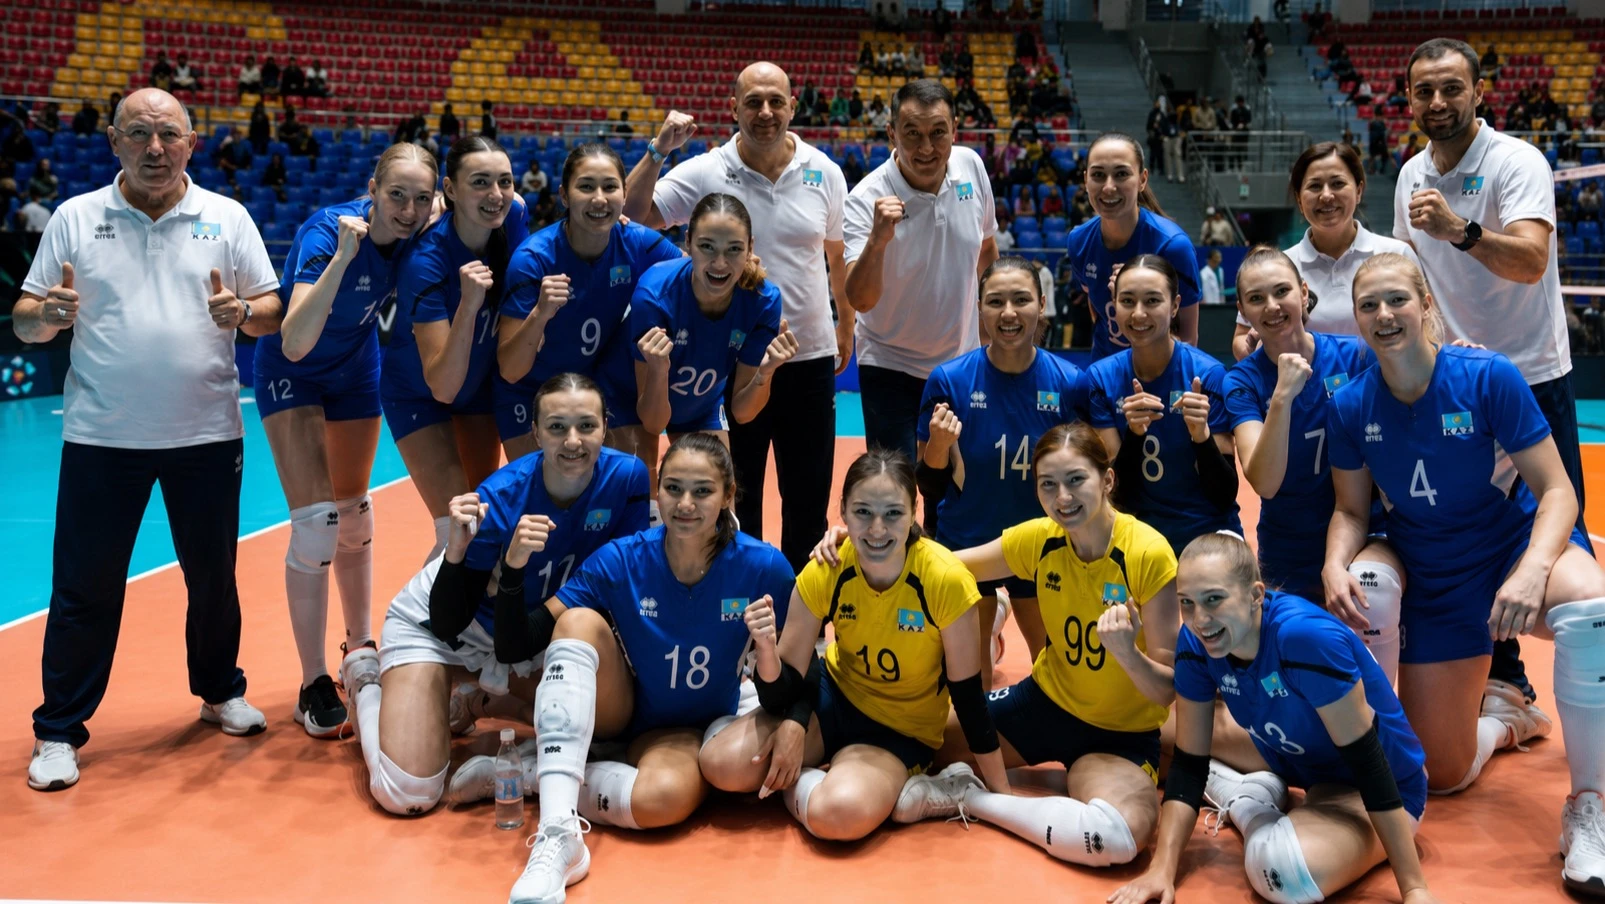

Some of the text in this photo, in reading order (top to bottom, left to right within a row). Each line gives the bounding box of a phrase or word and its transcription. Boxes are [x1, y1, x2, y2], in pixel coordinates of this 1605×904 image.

[580, 318, 601, 357] 9
[267, 378, 294, 402] 12
[670, 366, 718, 397] 20
[514, 403, 527, 424] 9
[1445, 426, 1472, 436] KAZ
[994, 433, 1032, 481] 14
[1142, 434, 1164, 482] 8
[1304, 427, 1326, 475] 7
[1409, 459, 1438, 506] 4
[898, 623, 924, 633] KAZ
[1064, 615, 1107, 672] 99
[664, 644, 711, 690] 18
[856, 644, 901, 682] 19
